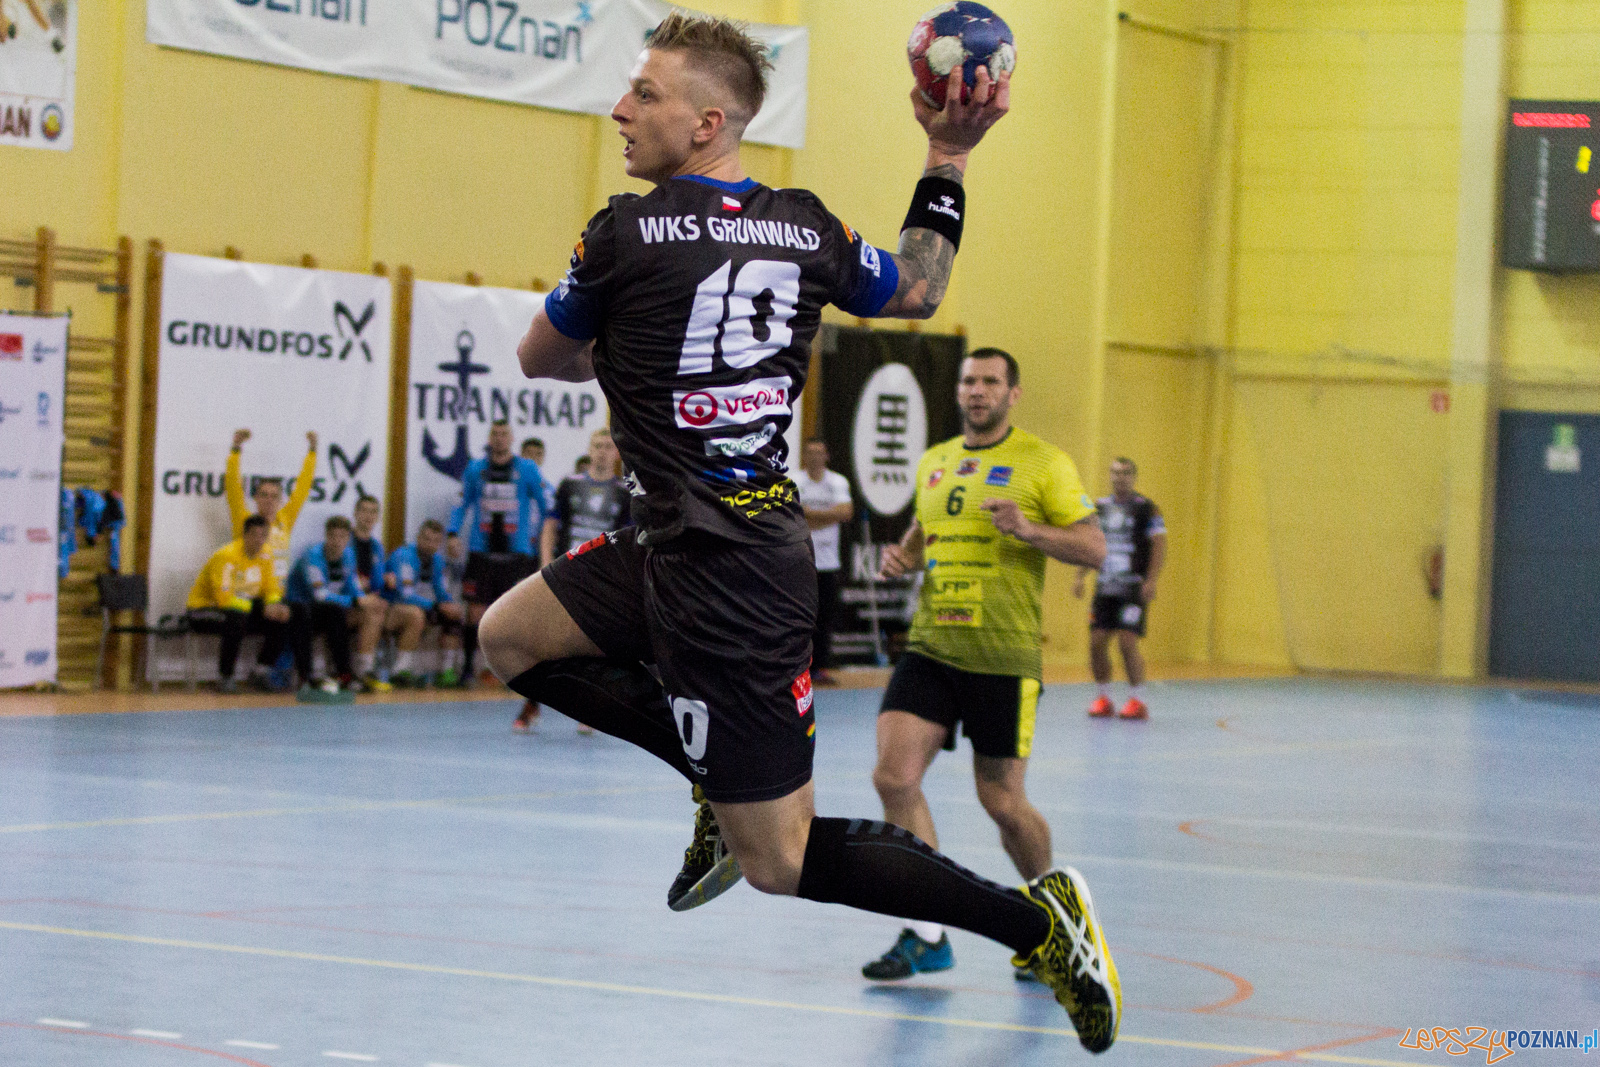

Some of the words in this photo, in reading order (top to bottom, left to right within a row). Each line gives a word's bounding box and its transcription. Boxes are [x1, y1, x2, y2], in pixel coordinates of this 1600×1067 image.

[638, 214, 701, 244] WKS
[706, 216, 821, 251] GRUNWALD
[676, 259, 801, 375] 10
[167, 319, 333, 359] GRUNDFOS
[414, 382, 597, 429] TRANSKAP
[723, 388, 785, 416] VEOLA
[946, 485, 967, 517] 6
